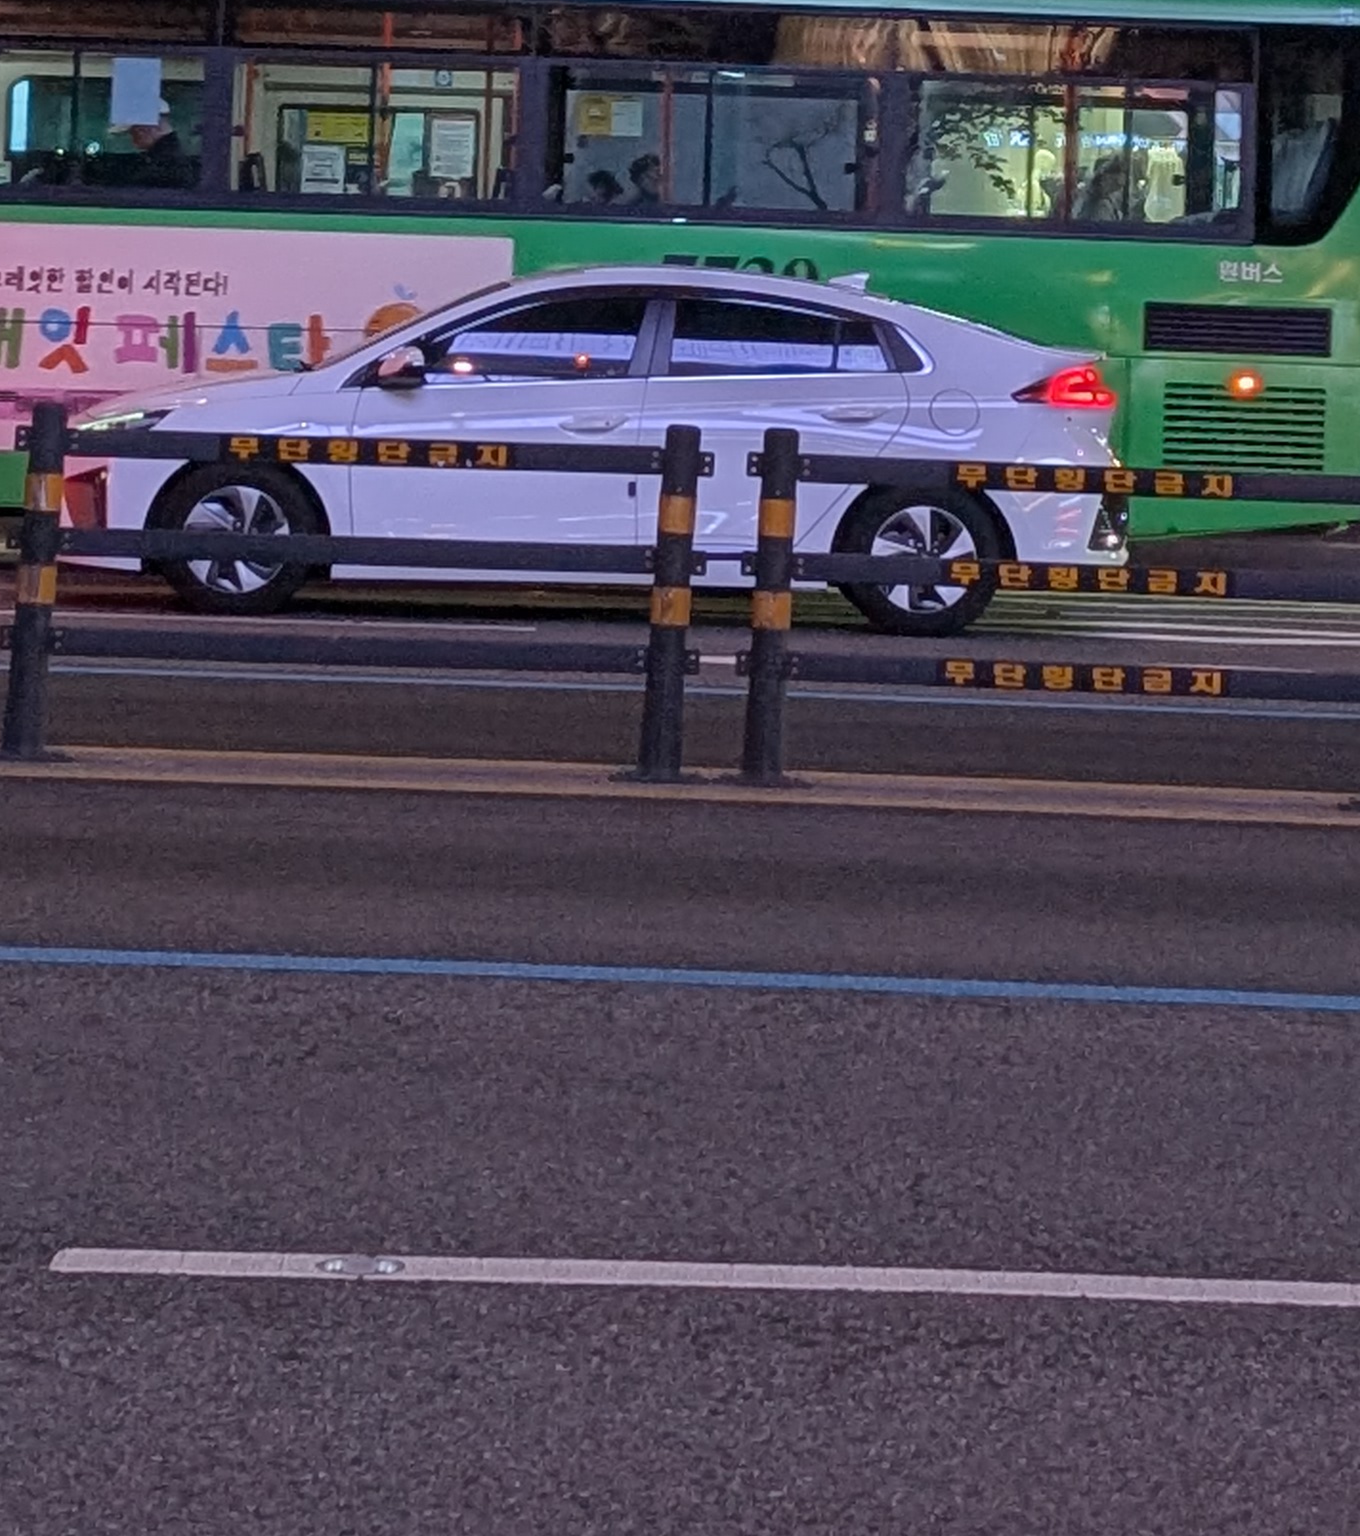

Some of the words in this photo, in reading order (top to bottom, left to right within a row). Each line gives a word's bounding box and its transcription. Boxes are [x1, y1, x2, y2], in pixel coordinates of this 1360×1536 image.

[74, 267, 134, 295] 할인이
[142, 269, 229, 297] 시작된다!
[1219, 260, 1285, 283] 원버스
[114, 310, 333, 374] 페스타
